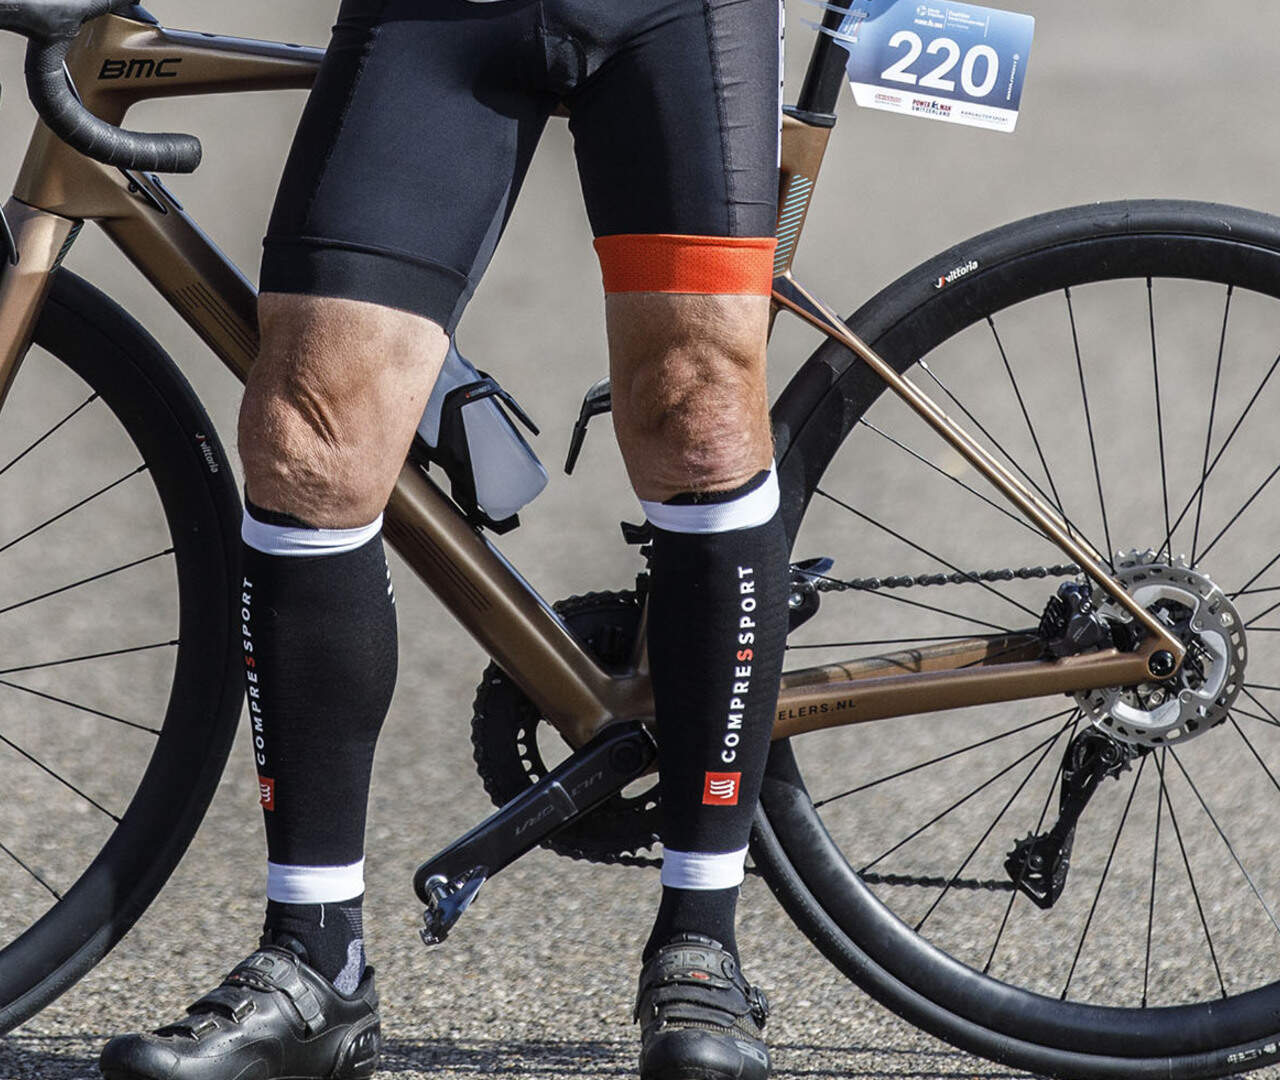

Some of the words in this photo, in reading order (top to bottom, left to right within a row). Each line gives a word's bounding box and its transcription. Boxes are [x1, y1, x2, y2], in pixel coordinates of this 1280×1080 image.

[97, 57, 183, 80] BMC
[880, 30, 999, 98] 220
[242, 576, 266, 767] COMPRESSPORT
[721, 565, 757, 764] COMPRESSPORT
